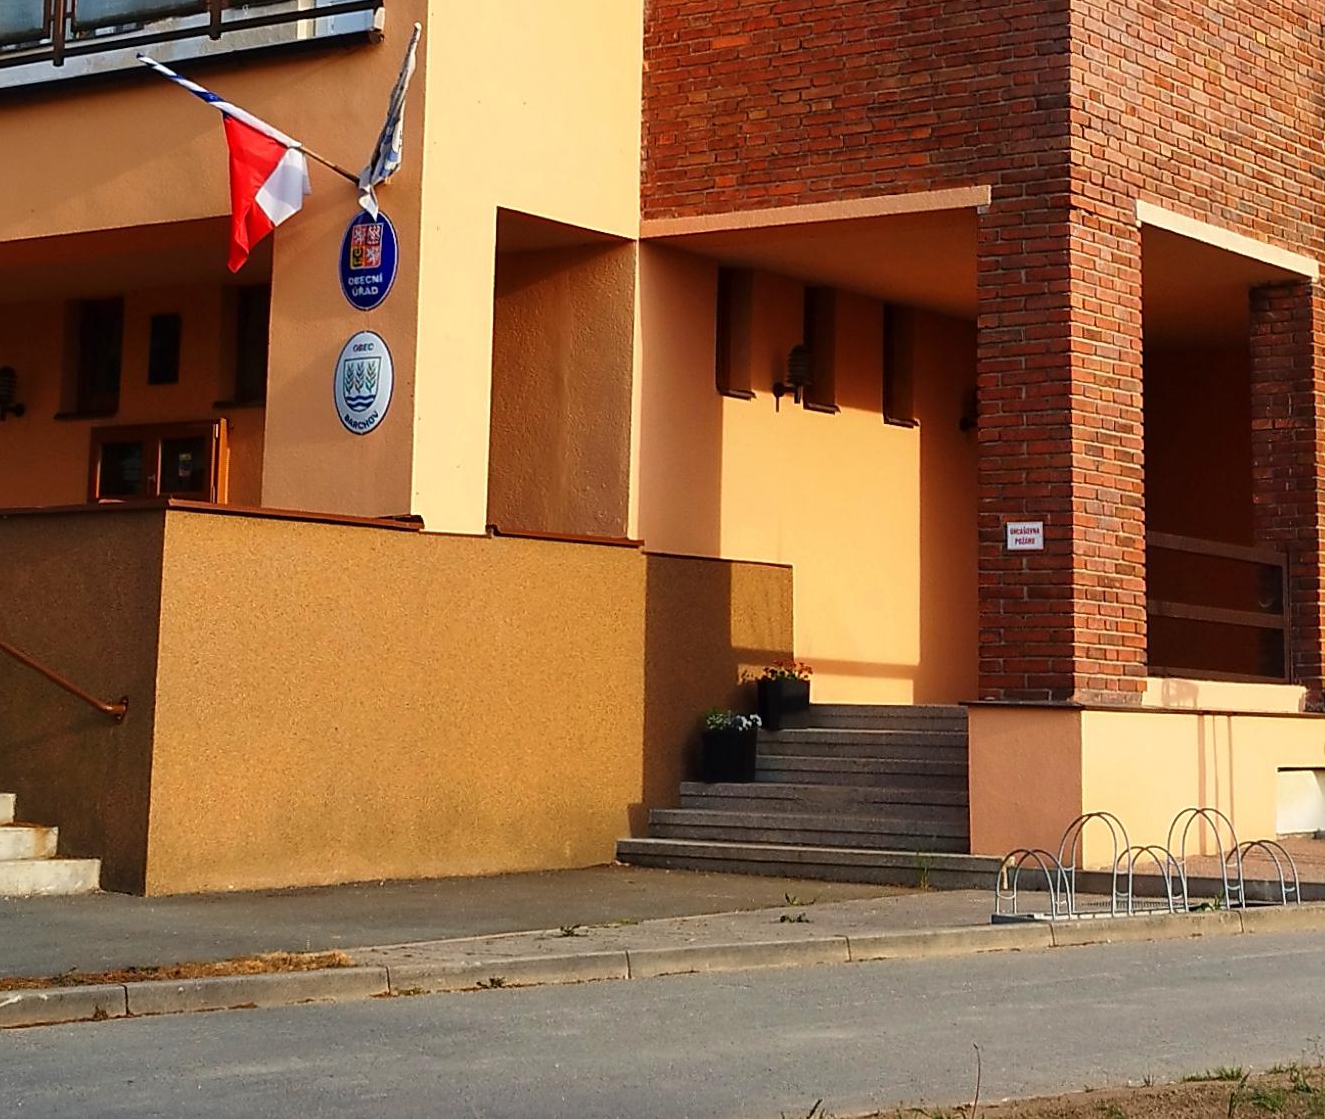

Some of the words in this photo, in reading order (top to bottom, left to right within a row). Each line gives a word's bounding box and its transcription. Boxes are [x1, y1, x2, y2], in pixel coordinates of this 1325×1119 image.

[348, 273, 383, 285] OBECNÍ
[352, 286, 379, 296] ÚŘAD
[353, 343, 374, 352] OBEC
[344, 411, 379, 429] BARCHOV
